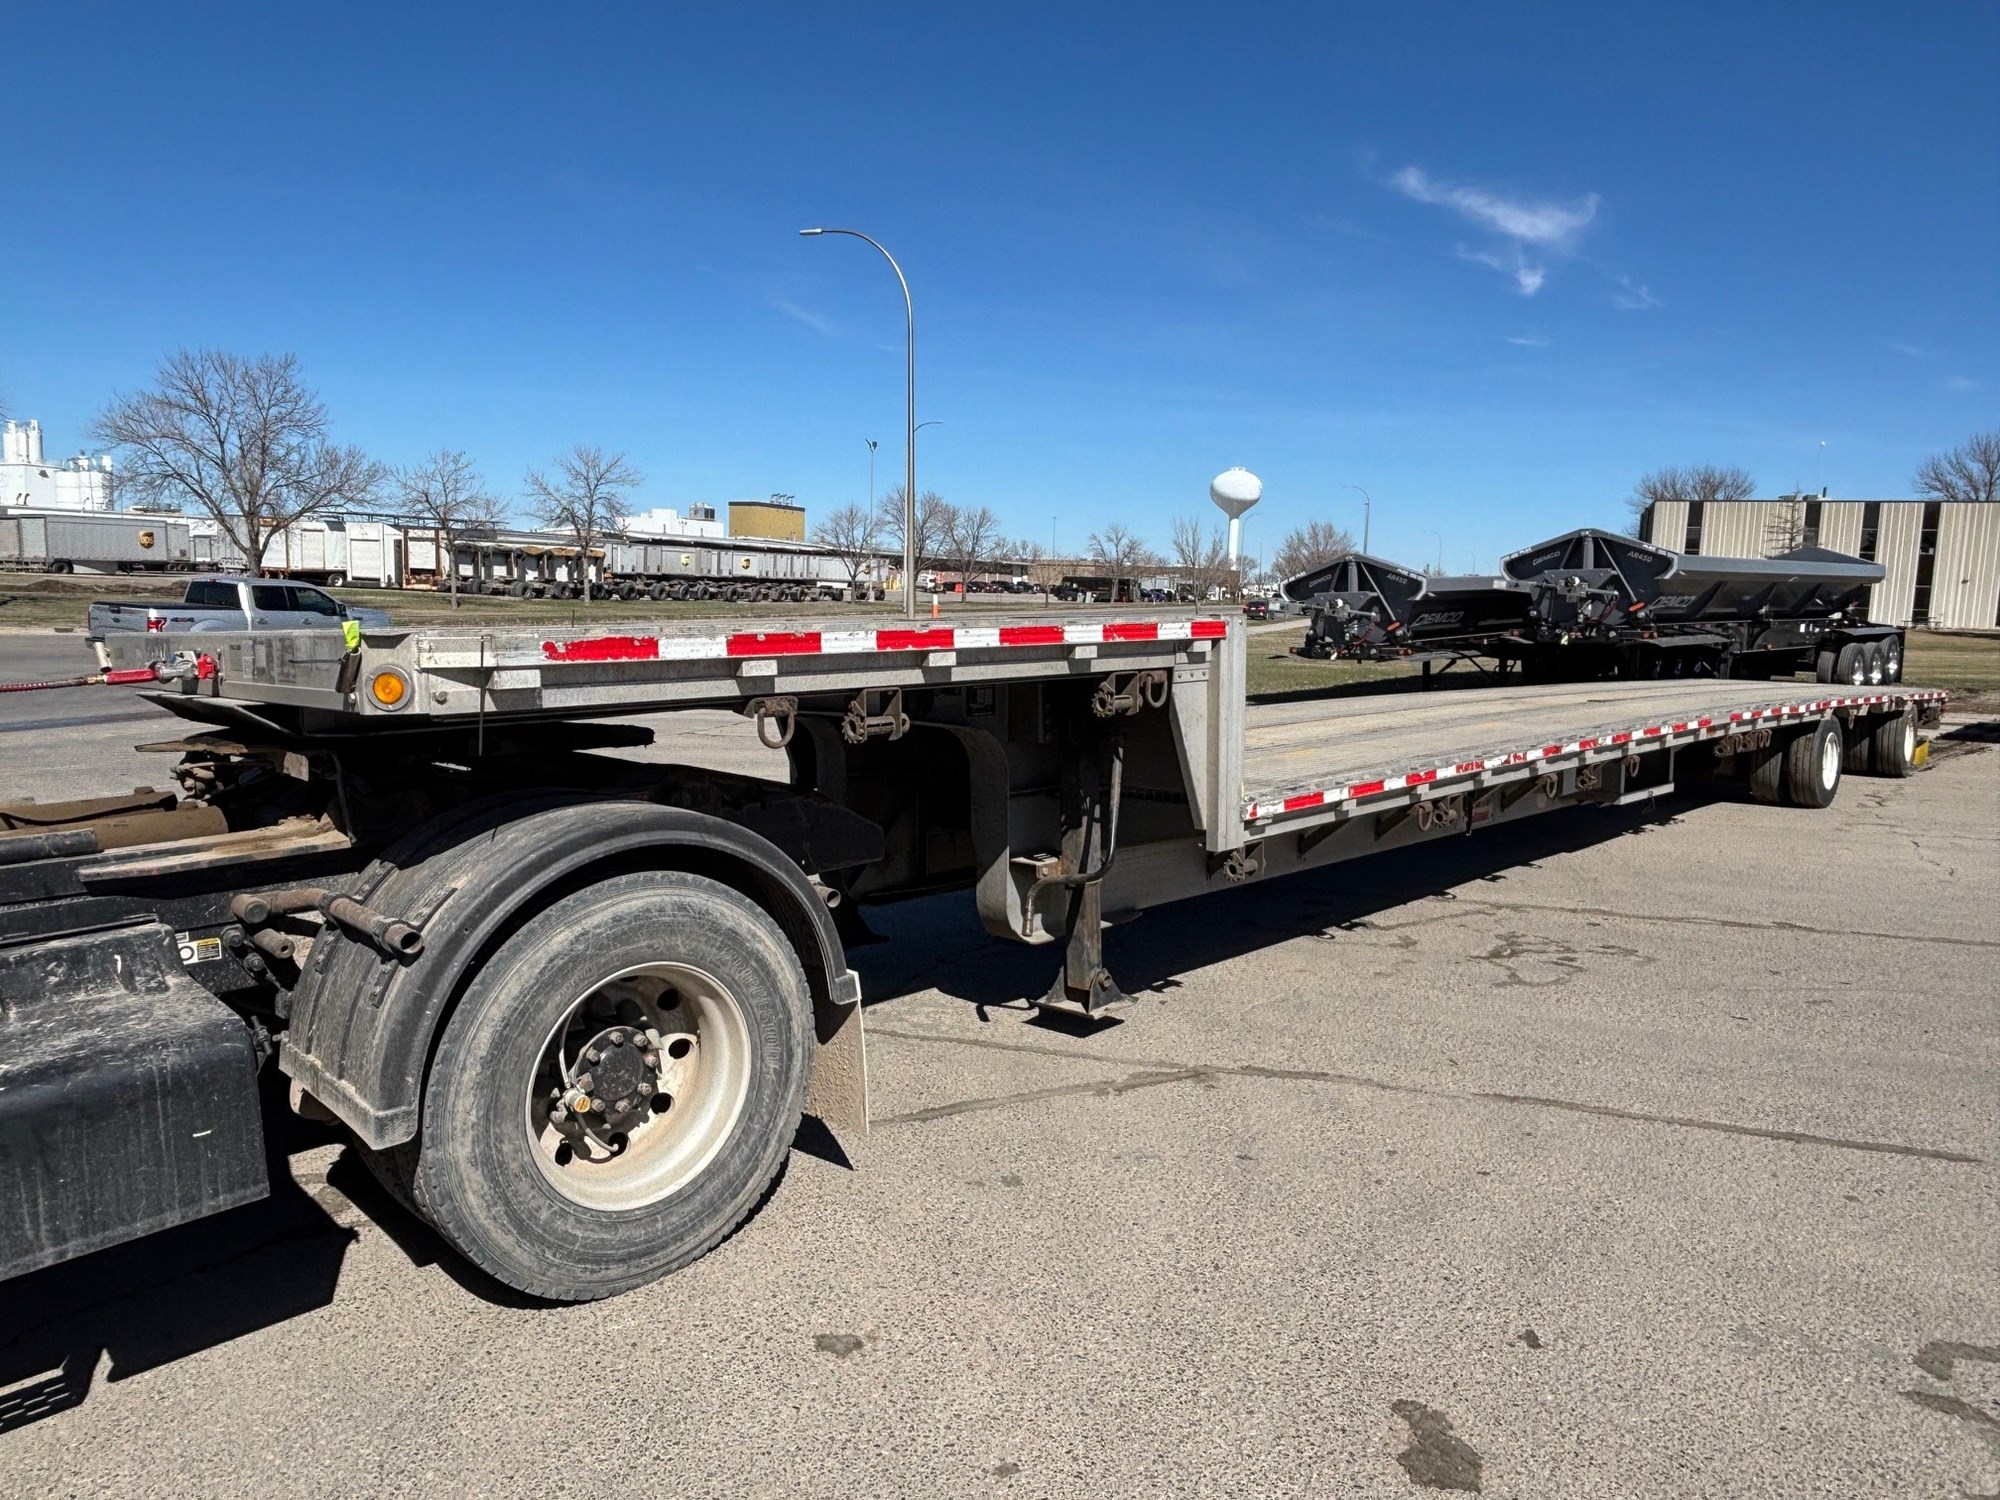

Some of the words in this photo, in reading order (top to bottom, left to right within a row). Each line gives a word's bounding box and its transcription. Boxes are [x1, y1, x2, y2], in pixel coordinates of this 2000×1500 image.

[1532, 550, 1561, 566] DEMCO
[1650, 595, 1696, 610] DEMCO
[1413, 611, 1465, 626] DEMCO
